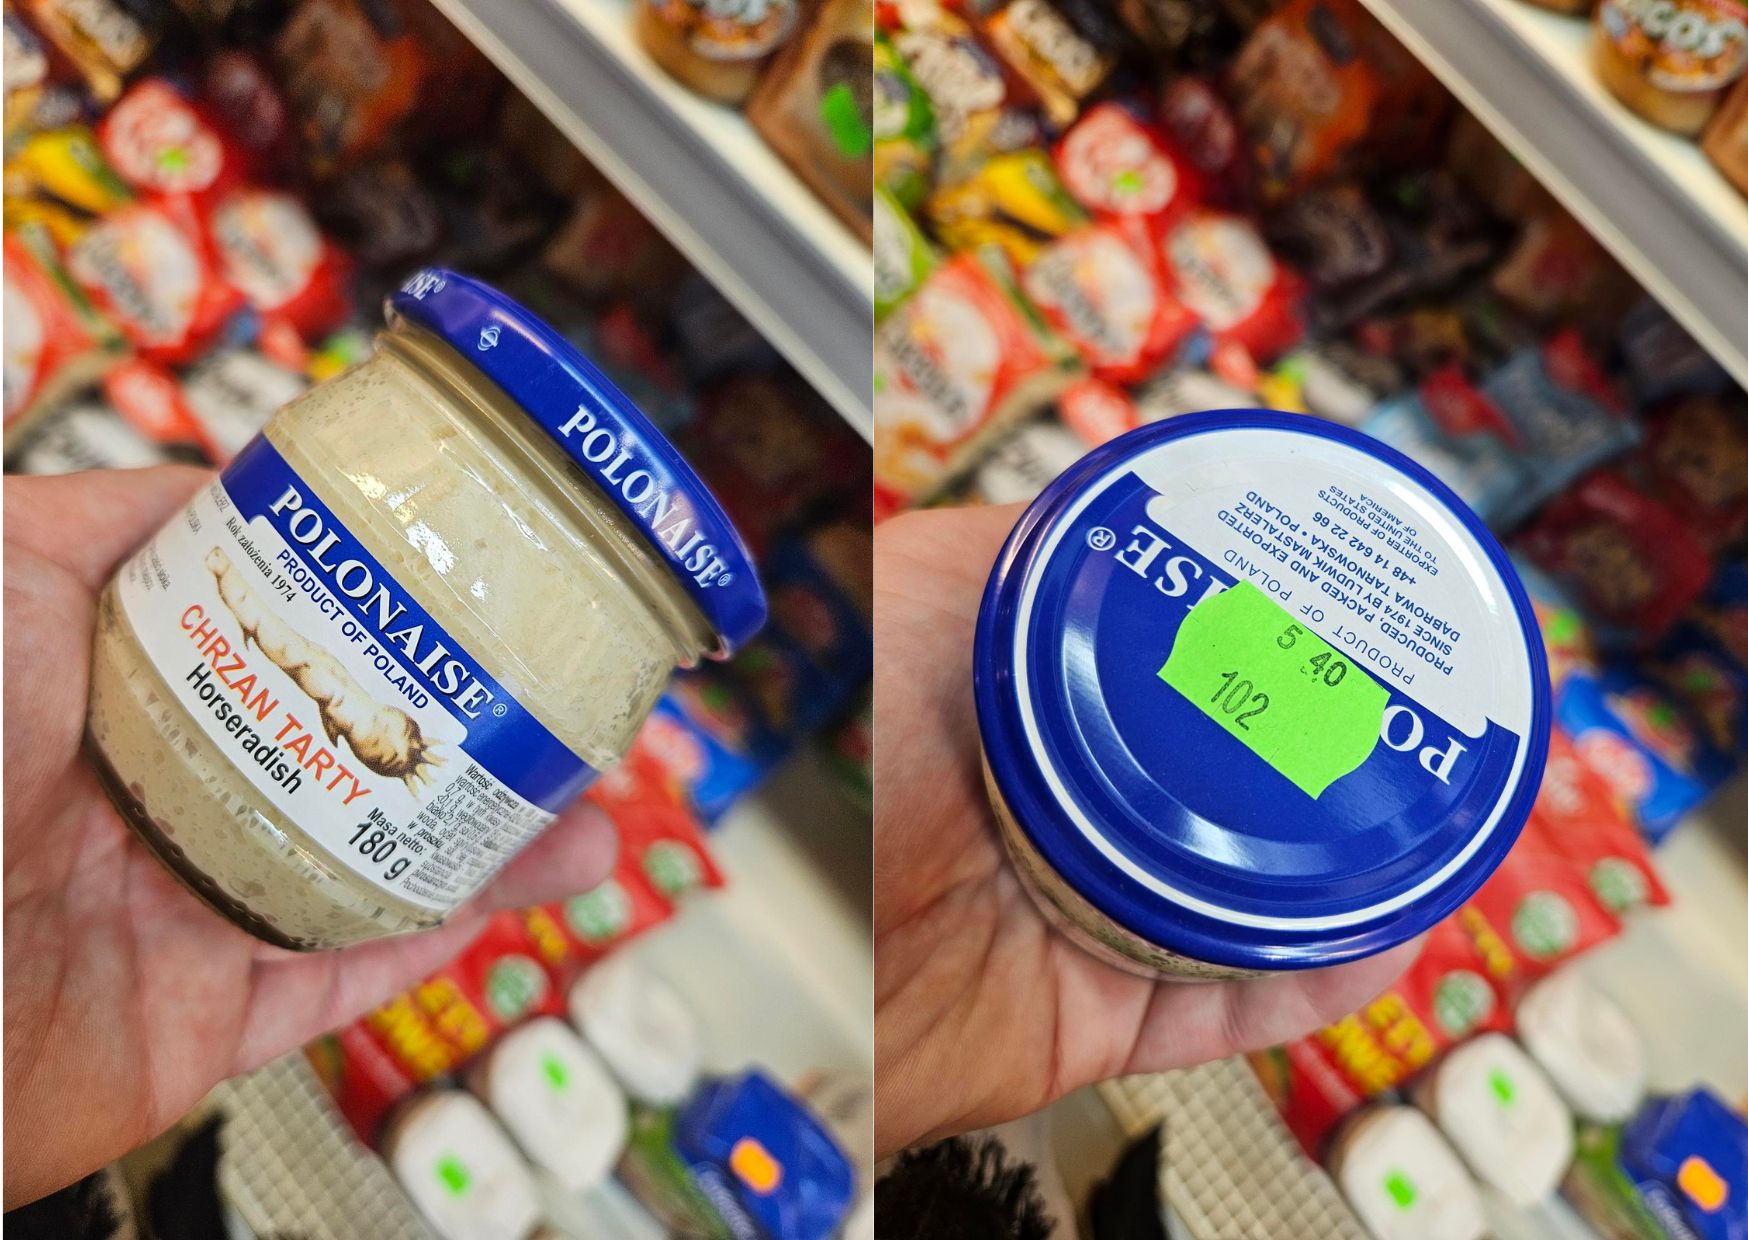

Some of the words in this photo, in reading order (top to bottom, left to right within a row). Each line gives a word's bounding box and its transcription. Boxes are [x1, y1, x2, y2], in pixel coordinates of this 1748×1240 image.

[1246, 491, 1301, 533] POLAND
[1312, 511, 1331, 528] 66
[1317, 489, 1371, 530] PRODUCTS
[1329, 485, 1367, 514] STATES
[1360, 493, 1403, 526] AMERICA
[1217, 509, 1290, 563] EXPORTED
[1234, 502, 1313, 561] MASTALERZ
[1330, 523, 1349, 541] 22
[1368, 511, 1403, 540] UNITED
[1370, 528, 1386, 541] OF
[1402, 526, 1417, 537] OF
[1403, 535, 1422, 554] THE
[225, 516, 241, 538] Rok
[237, 534, 274, 579] założenia
[270, 574, 297, 603] 1974
[1310, 534, 1391, 597] TARNOWSKA
[1348, 536, 1373, 558] 642
[1374, 553, 1390, 570] 14
[1386, 536, 1439, 577] EXPORTER
[1424, 551, 1437, 565] TO
[1223, 549, 1293, 601] POLAND
[1290, 560, 1320, 583] AND
[1312, 555, 1364, 596] LUDWIK
[1392, 566, 1417, 585] +48
[1299, 604, 1325, 623] OF
[1320, 581, 1376, 623] PACKED
[1363, 592, 1383, 609] BY
[1383, 604, 1412, 628] 1974
[1394, 591, 1461, 643] DĄBROWA
[276, 549, 344, 621] PRODUCT
[341, 621, 368, 644] OF
[363, 644, 429, 710] POLAND
[1379, 616, 1454, 676] PRODUCED,
[1412, 623, 1453, 656] SINCE
[1276, 624, 1304, 650] 5
[1309, 651, 1348, 687] 40
[1332, 625, 1416, 685] PRODUCT
[180, 604, 280, 722] CHRZAN
[274, 713, 373, 806] TARTY
[1210, 671, 1270, 731] 102
[186, 663, 302, 795] Horseradish
[348, 822, 398, 864] 180
[384, 856, 412, 881] g
[367, 807, 398, 835] Masa
[396, 830, 428, 857] netto:
